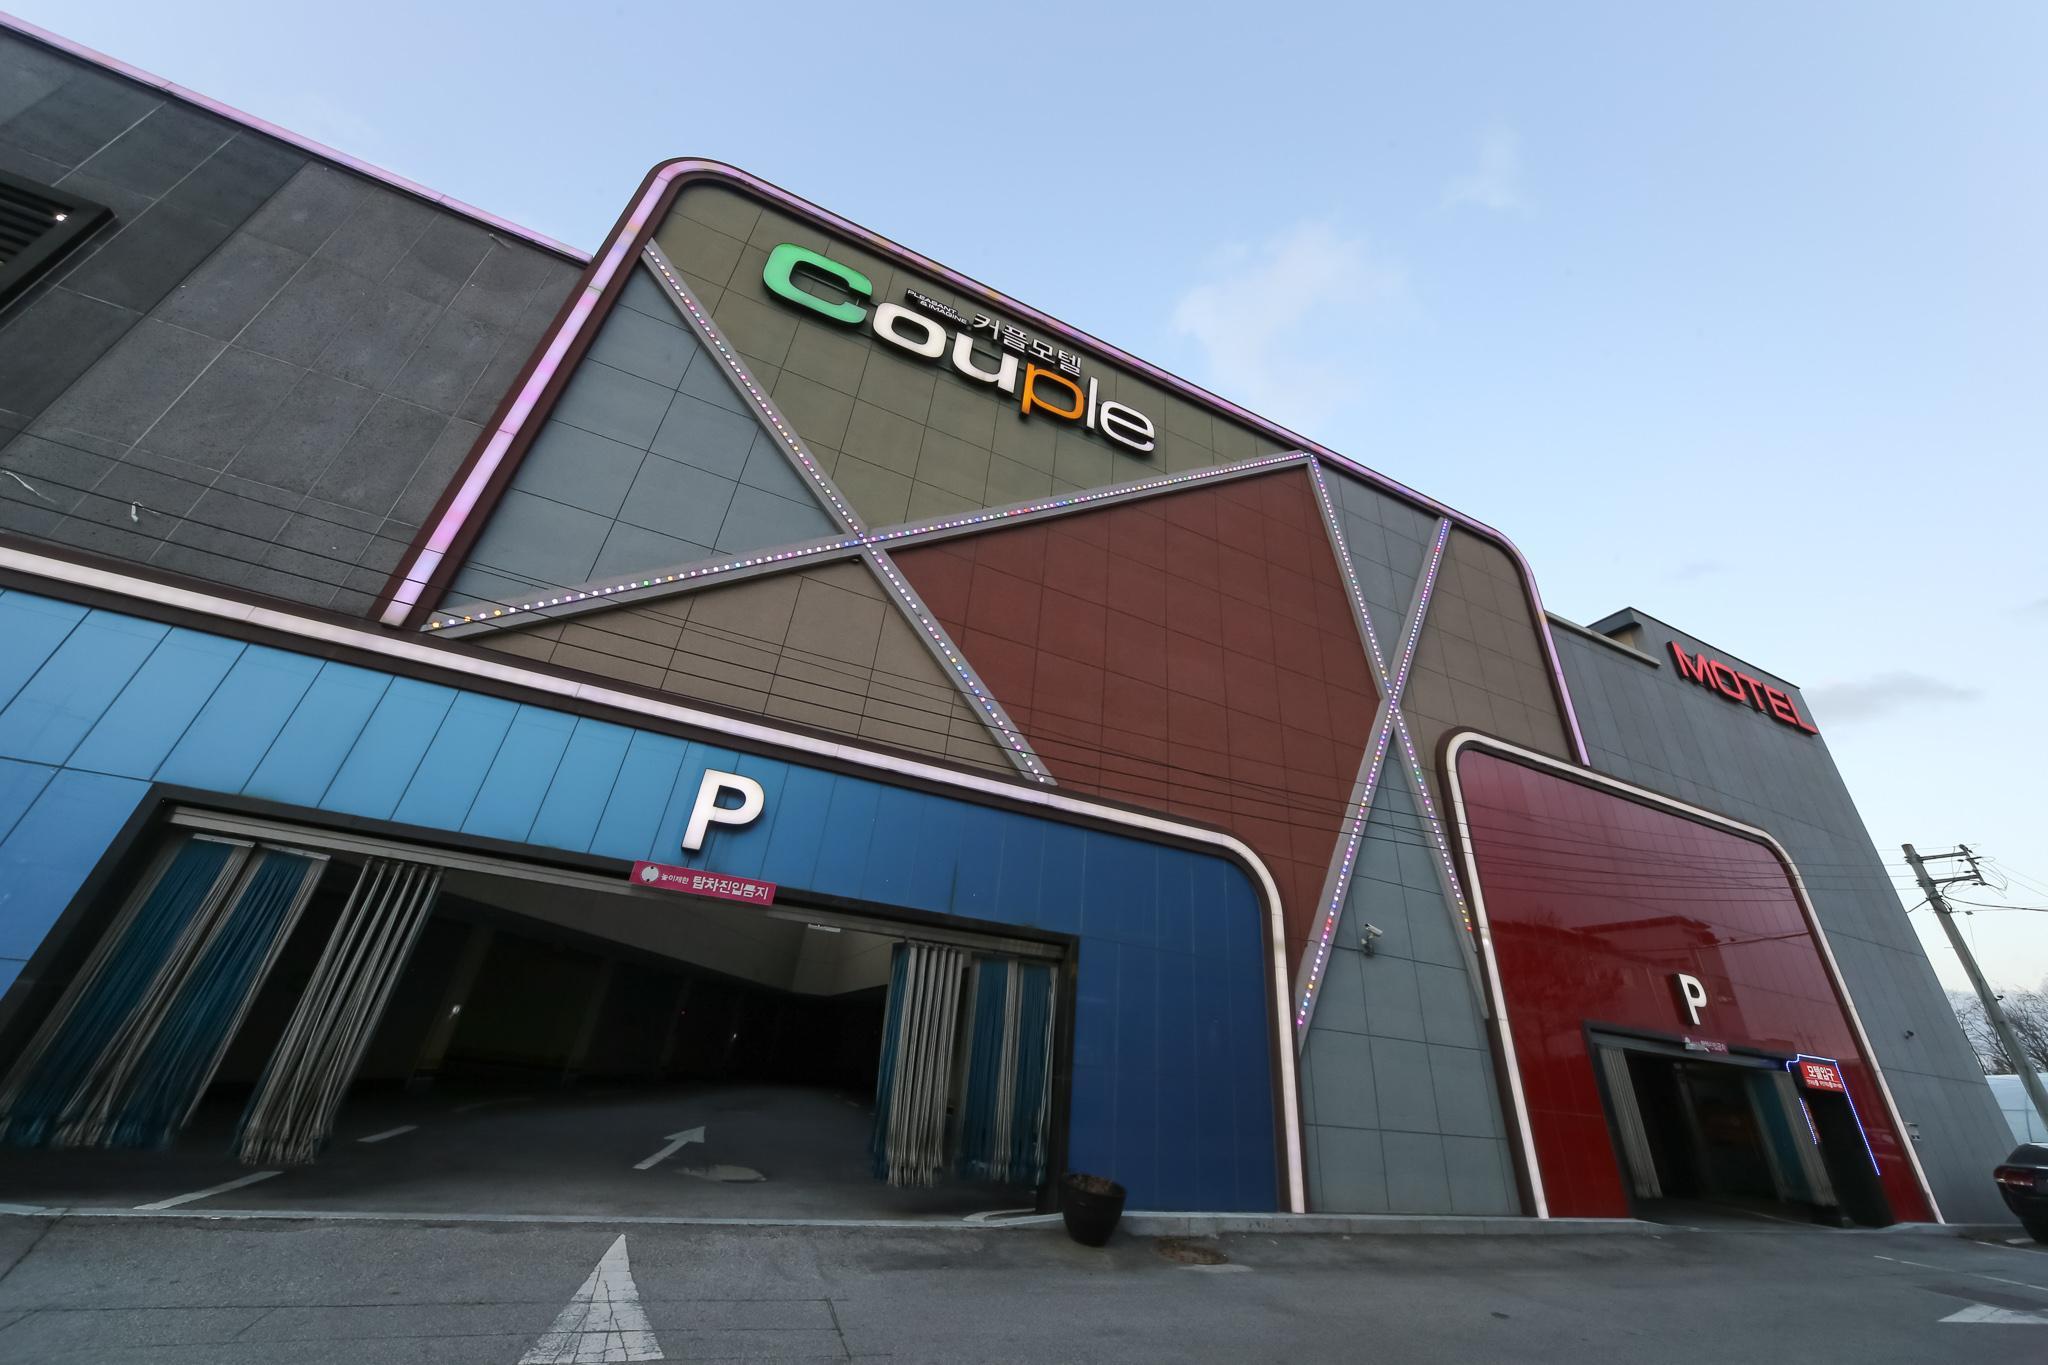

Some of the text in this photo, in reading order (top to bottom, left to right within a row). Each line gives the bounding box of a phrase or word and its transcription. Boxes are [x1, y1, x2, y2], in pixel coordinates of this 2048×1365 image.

[907, 289, 957, 313] PLEASANT
[762, 242, 1156, 453] Couple
[973, 313, 1081, 377] 커플모텔
[1669, 640, 1819, 735] MOTEL
[681, 768, 765, 851] P
[1678, 973, 1707, 1025] P
